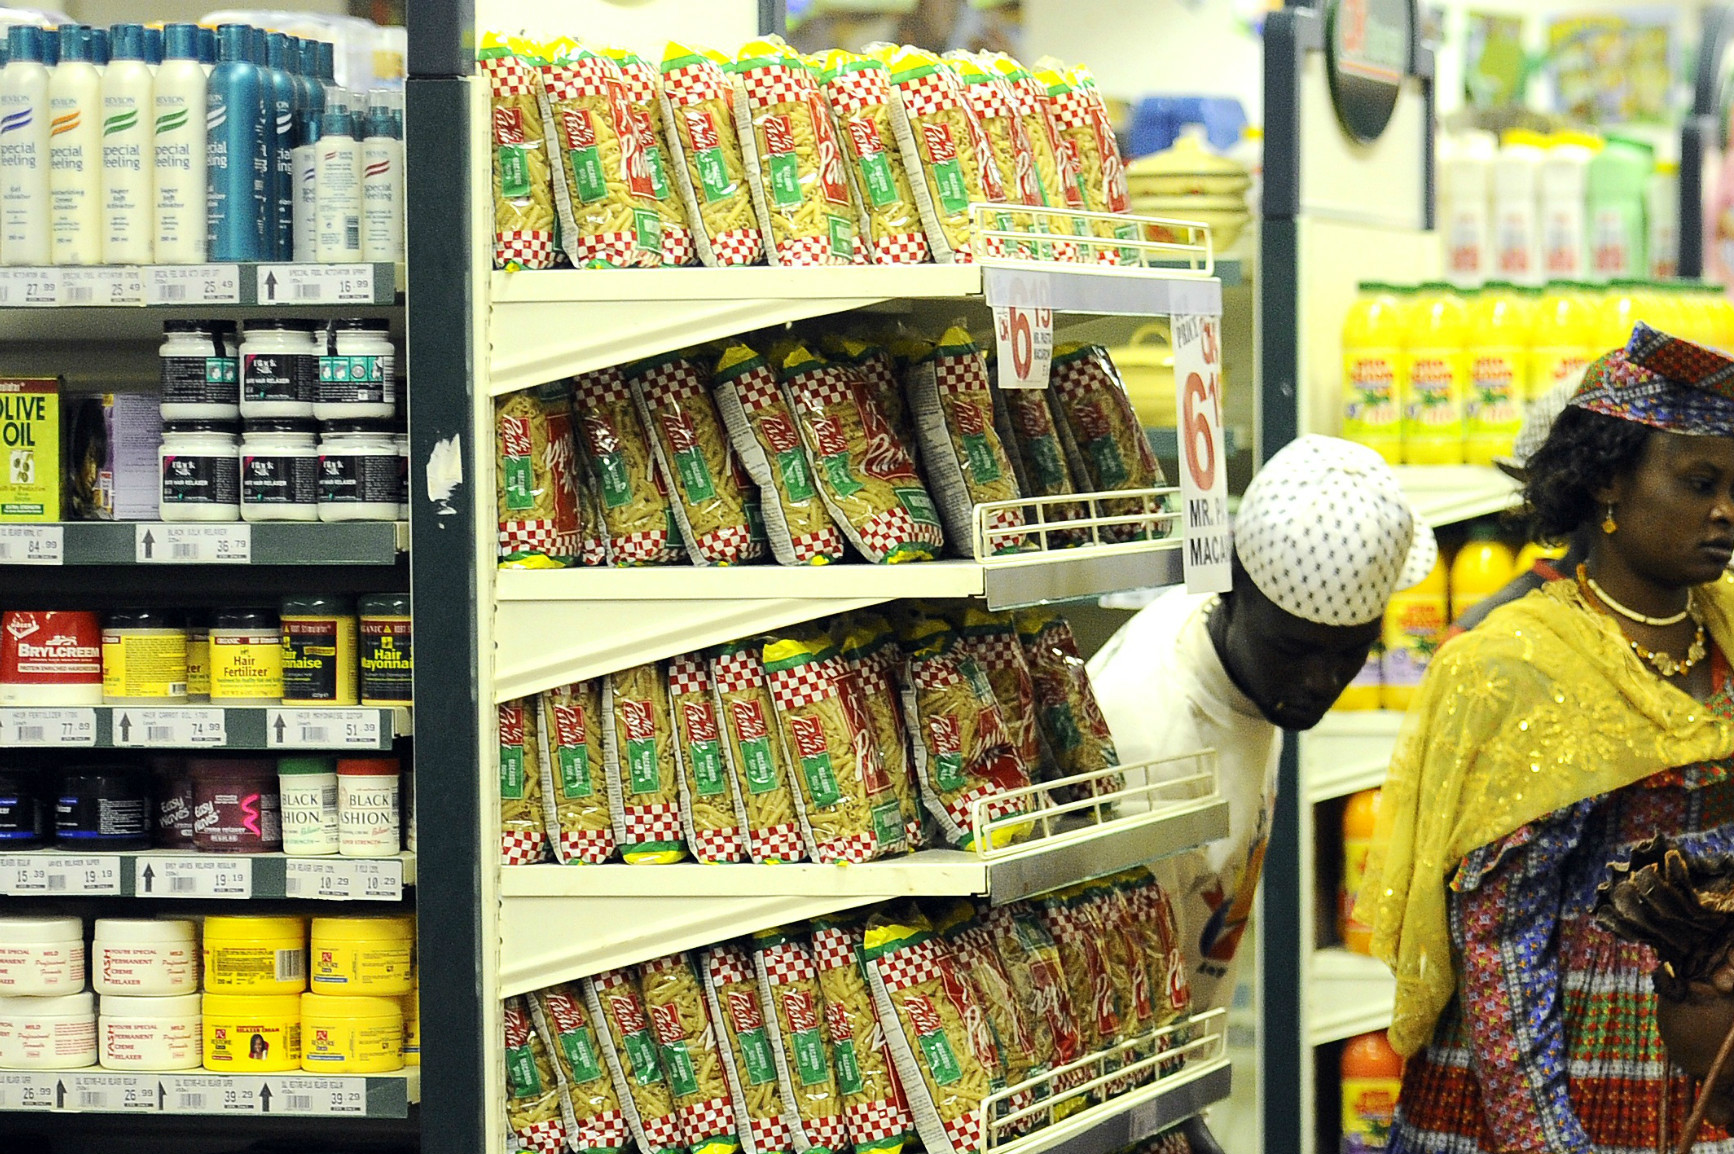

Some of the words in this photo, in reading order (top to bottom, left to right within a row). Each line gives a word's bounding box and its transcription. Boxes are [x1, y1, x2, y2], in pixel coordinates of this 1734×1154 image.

[3, 422, 35, 447] OIL
[1183, 372, 1215, 491] 6
[1190, 499, 1213, 529] MR.
[18, 643, 100, 658] BRYLCREEM
[374, 648, 402, 659] Hair
[233, 656, 256, 666] Hair
[223, 667, 268, 677] Fertilizer
[283, 793, 318, 807] BLACK
[349, 793, 390, 807] BLACK
[195, 801, 213, 818] Easy
[103, 949, 111, 983] TASH
[107, 1024, 115, 1059] TASH
